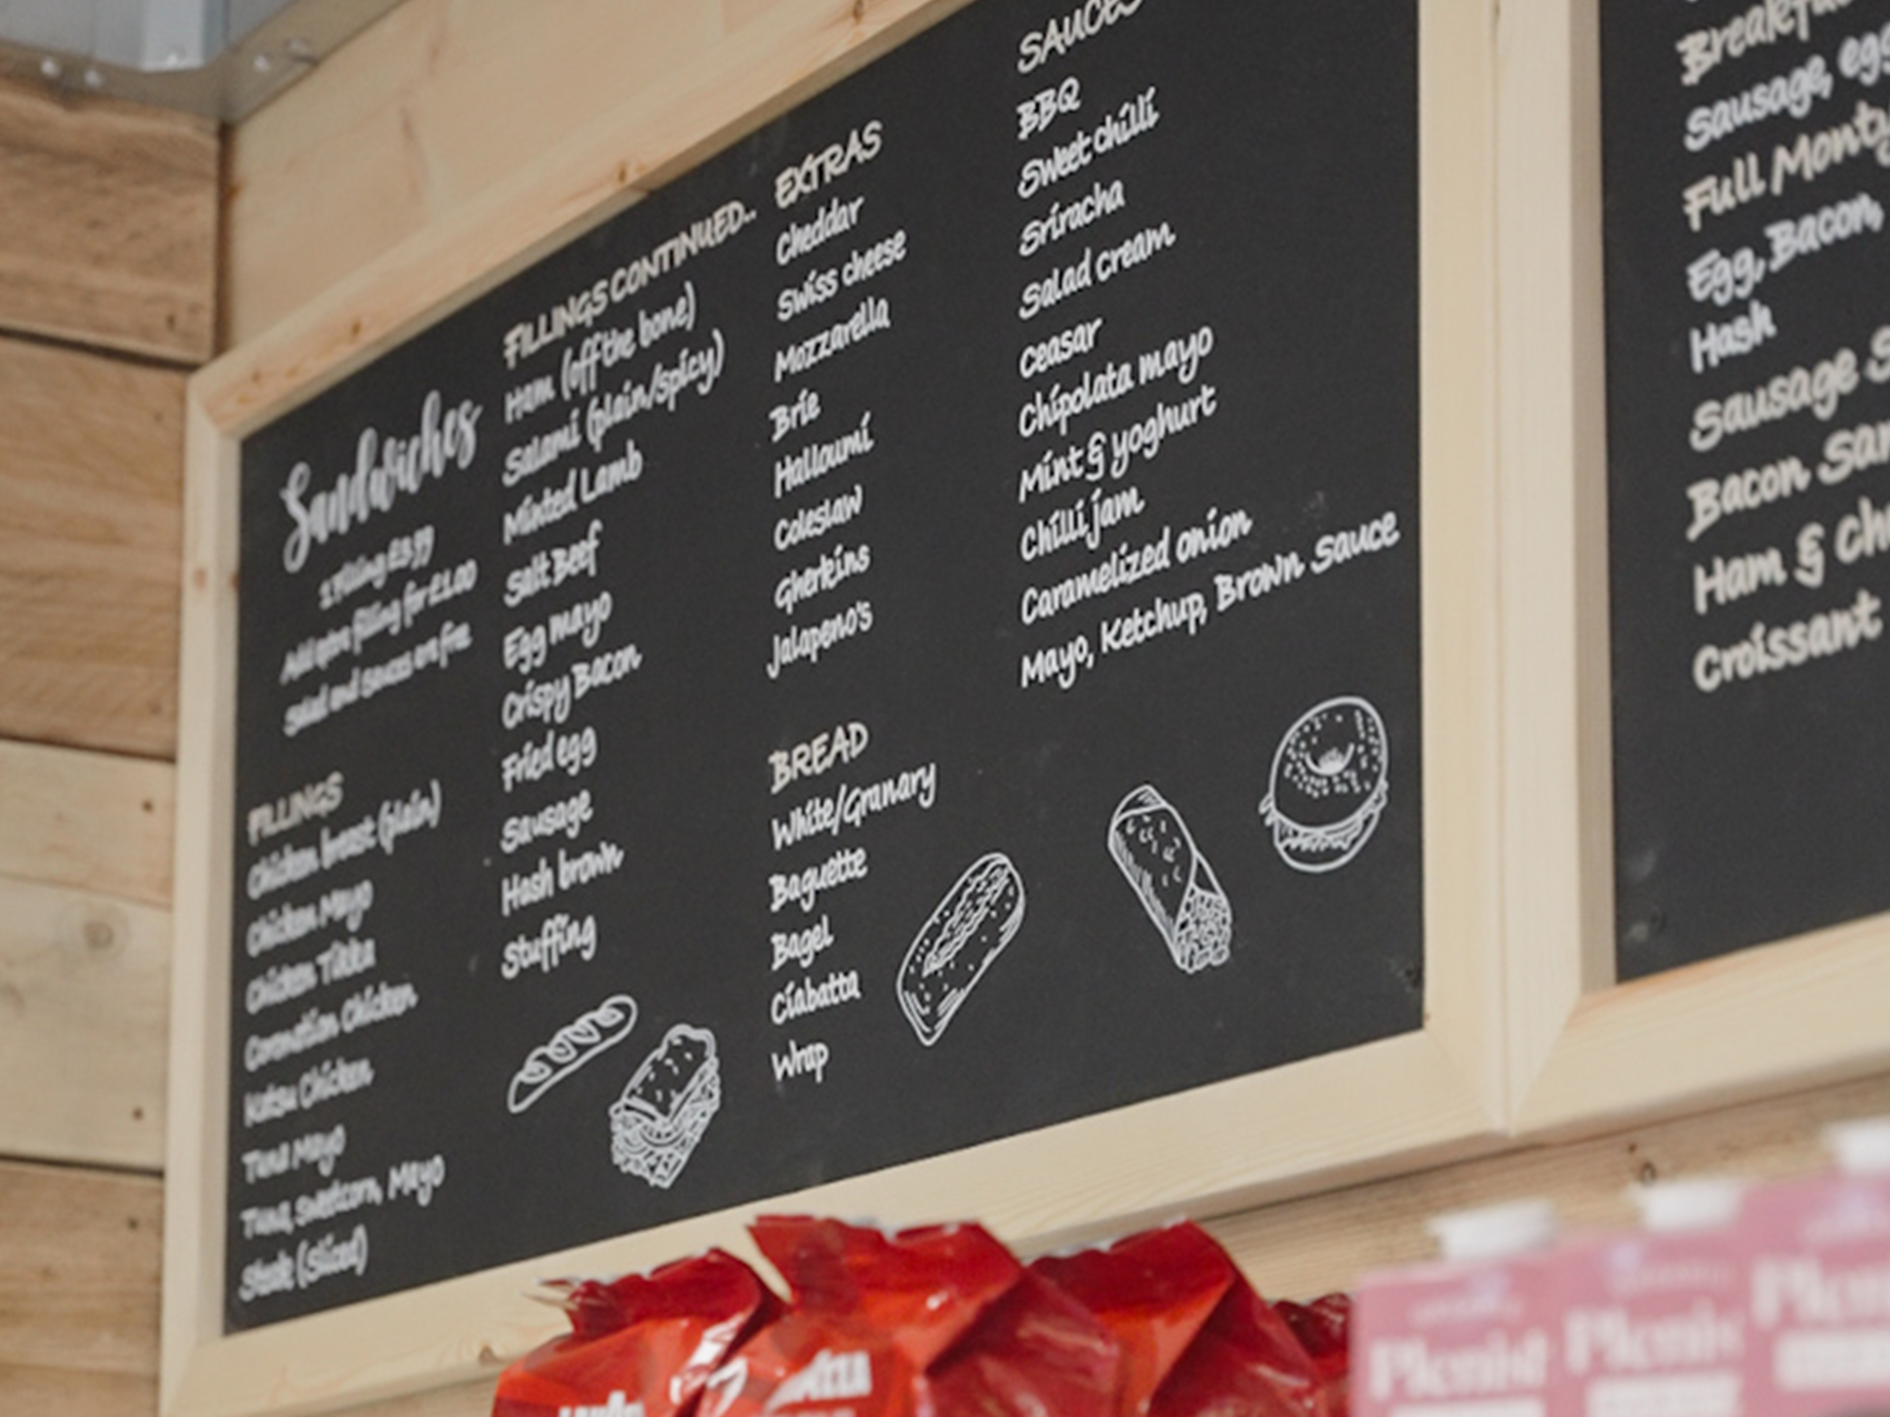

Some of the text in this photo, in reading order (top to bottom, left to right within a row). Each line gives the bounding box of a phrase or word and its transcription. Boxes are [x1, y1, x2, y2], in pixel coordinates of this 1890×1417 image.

[1675, 0, 1852, 86] Breakf
[1015, 75, 1082, 141] BBQ
[1017, 85, 1161, 199] Sweet chilli
[773, 119, 883, 209] EXTRAS
[1681, 99, 1890, 233] Full Monty
[775, 195, 866, 267] Cheddar
[1018, 178, 1126, 258] Sriracha
[776, 228, 908, 323] Swiss cheese
[1018, 220, 1177, 320] Salad cream
[1685, 247, 1767, 307] Egg,
[503, 278, 609, 371] FILLINGS
[504, 375, 556, 425] Ham
[599, 327, 638, 369] the
[638, 279, 697, 349] bone)
[773, 296, 892, 383] Mozzarella
[1689, 298, 1778, 374] Hash
[502, 327, 726, 488] Salami (plain/spicy)
[768, 387, 823, 443] Brie
[1018, 325, 1215, 438] Chipolata mayo
[1688, 347, 1860, 453] Sausage
[279, 389, 484, 573] Sandwiches
[773, 410, 876, 499] Halloumi
[1018, 446, 1085, 503] Mint
[1109, 383, 1218, 479] yoghurt
[503, 438, 644, 544] Minted Lamb
[773, 483, 864, 551] Coleslaw
[1019, 486, 1146, 563] Chilli jam
[1685, 456, 1812, 542] Bacon
[504, 518, 604, 608] Salt Beef
[773, 543, 872, 616] Gherkins
[1019, 506, 1254, 626] Caramelized onion
[1692, 546, 1788, 616] Ham
[1834, 496, 1890, 565] Ch
[502, 624, 548, 675] Egg
[766, 599, 874, 680] Jalapeno's
[1019, 634, 1096, 690] Mayo,
[1099, 591, 1209, 655] Ketchup,
[1212, 550, 1306, 613] Brown
[1691, 589, 1884, 693] Croissant
[501, 642, 643, 730] Crispy Bacon
[501, 725, 598, 793] Fried egg
[767, 721, 870, 795] BREAD
[247, 771, 344, 847] FILLINGS
[500, 788, 595, 854] Sausage
[770, 762, 938, 851] White/Granary
[247, 844, 320, 900] Chicken
[501, 839, 626, 917] Hash brown
[768, 847, 869, 913] Baguette
[246, 903, 318, 958] Chicken
[500, 911, 598, 980] Stuffing
[769, 914, 835, 972] Bagel
[245, 962, 318, 1015] Chicken
[341, 981, 419, 1033] Chicken
[769, 969, 862, 1026] Ciabatta
[298, 1056, 376, 1110] Chicken
[770, 1039, 830, 1084] Wrap
[241, 1141, 291, 1184] Tuna
